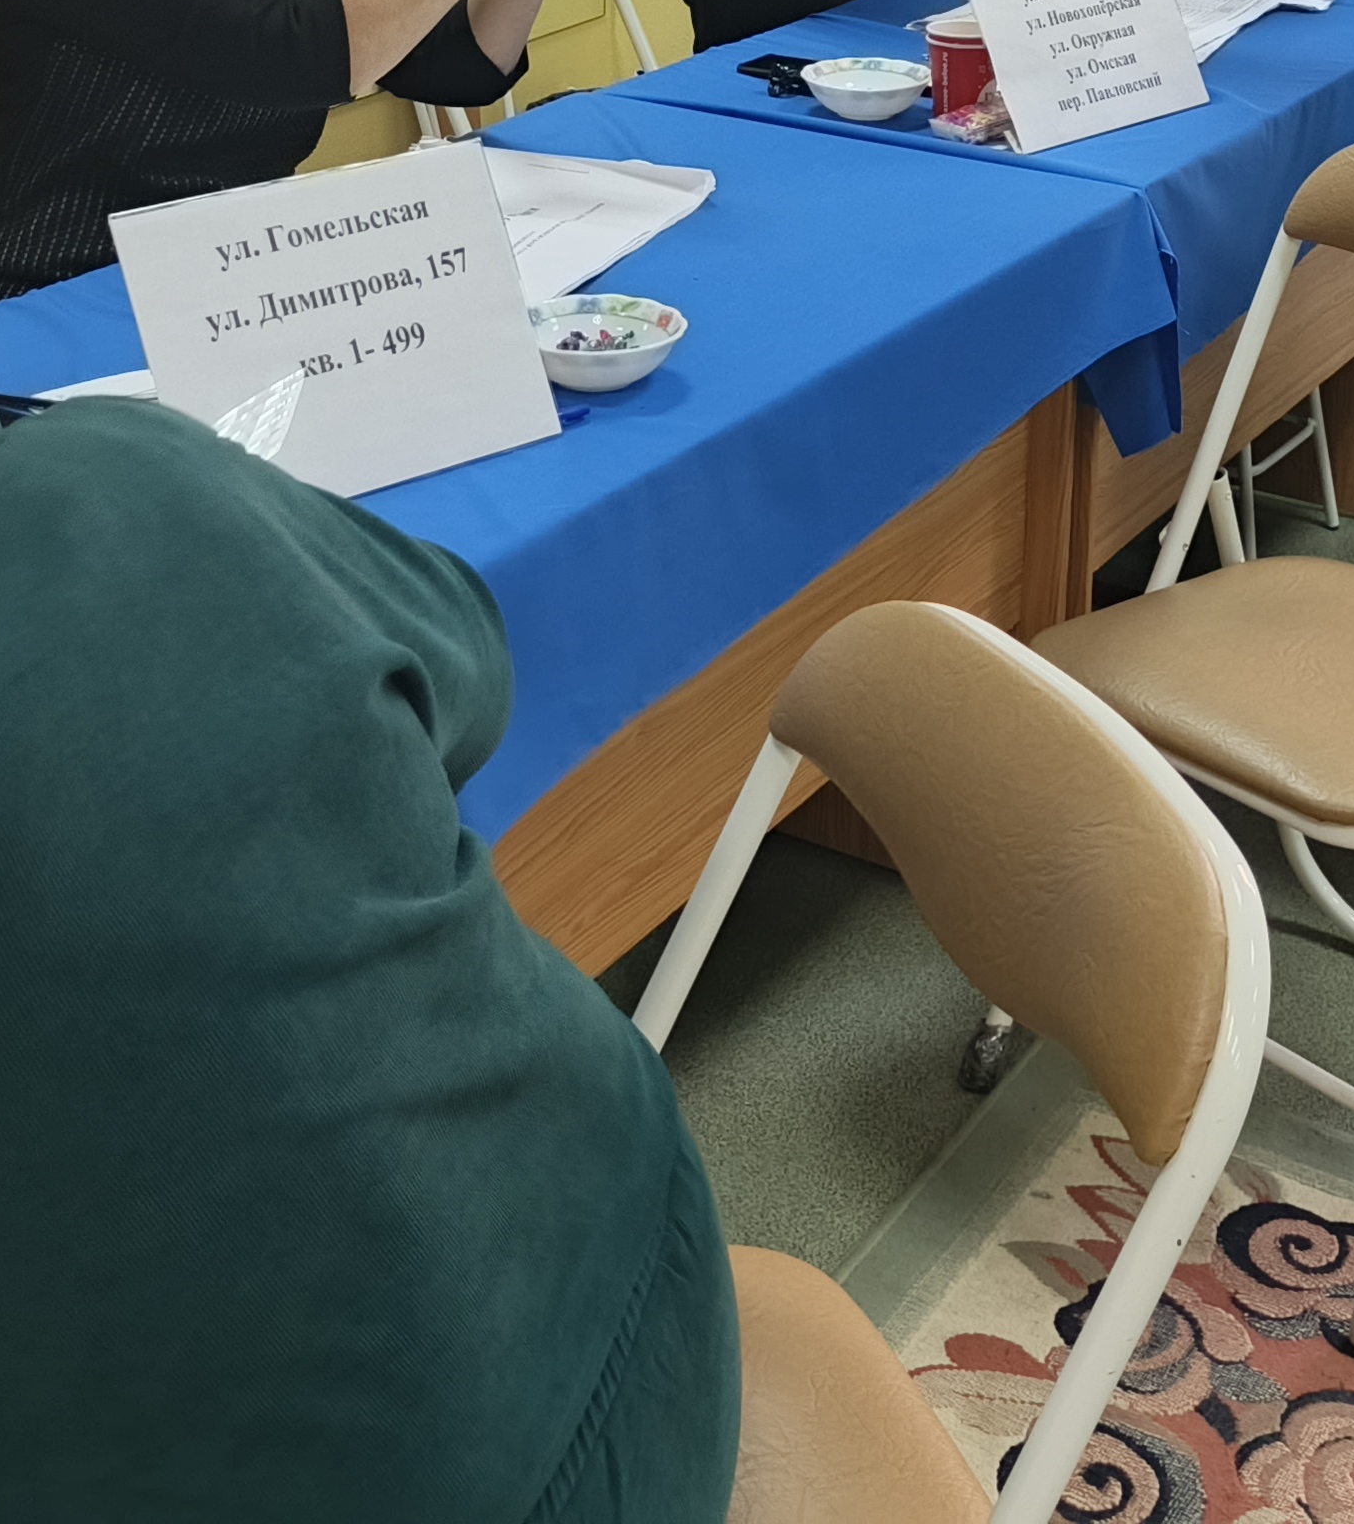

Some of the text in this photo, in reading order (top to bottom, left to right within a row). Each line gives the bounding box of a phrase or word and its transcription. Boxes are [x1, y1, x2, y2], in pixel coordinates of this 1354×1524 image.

[1026, 16, 1046, 36] ул.
[1049, 22, 1136, 58] ул. Окружная
[1066, 50, 1137, 85] ул. Омская
[1058, 72, 1162, 115] пер. Павловский
[215, 200, 429, 271] ул. Гомельская
[205, 248, 468, 342] ул. Димитрова, 157
[299, 353, 343, 378] кв.
[382, 322, 427, 355] 499
